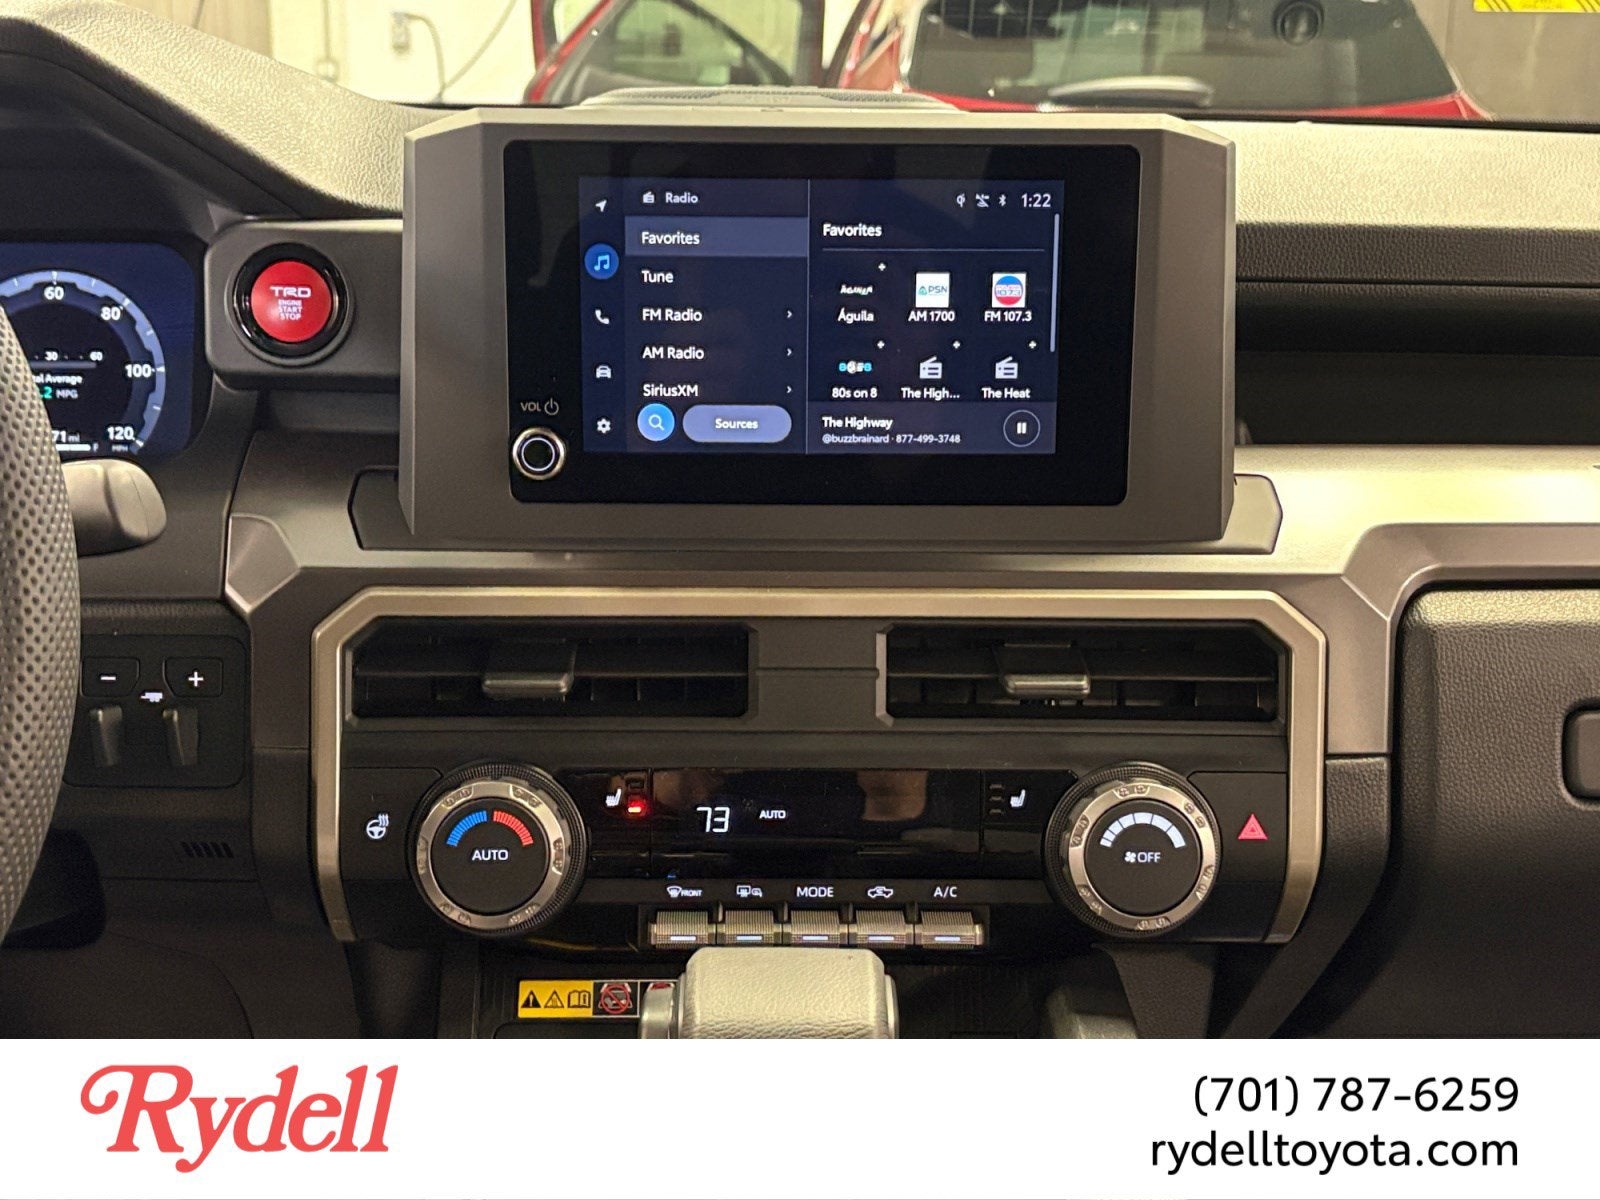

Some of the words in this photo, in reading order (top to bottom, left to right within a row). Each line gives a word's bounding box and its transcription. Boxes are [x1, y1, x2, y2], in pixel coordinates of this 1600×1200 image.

[665, 192, 698, 204] Radio
[1021, 193, 1051, 208] 1:22
[823, 224, 882, 237] Favorites
[641, 231, 700, 245] Favorites
[641, 270, 674, 283] Tune
[44, 286, 64, 300] 60
[269, 286, 312, 298] TRD
[928, 285, 948, 294] PSN
[101, 306, 121, 320] 80
[642, 309, 662, 321] FM
[665, 309, 702, 322] Radio
[838, 307, 874, 324] Águila
[908, 311, 927, 322] AM
[929, 311, 955, 322] 1700
[984, 311, 1001, 322] FM
[1003, 311, 1032, 322] 107.3
[45, 351, 59, 361] 30
[89, 351, 103, 361] 60
[642, 347, 664, 359] AM
[667, 347, 704, 360] Radio
[125, 364, 151, 377] 100
[45, 374, 83, 385] Average
[55, 389, 79, 399] MPG
[643, 384, 699, 397] SiriusXM
[832, 387, 851, 398] 80s
[853, 390, 869, 398] on
[870, 387, 878, 398] 8
[901, 388, 922, 398] The
[923, 387, 960, 401] High...
[982, 388, 1002, 398] The
[1004, 388, 1030, 398] Heat
[520, 401, 541, 411] VOL
[715, 418, 758, 430] Sources
[822, 417, 843, 427] The
[845, 417, 893, 430] Highway
[68, 434, 80, 442] mi
[107, 427, 134, 440] 120
[822, 434, 889, 444] @buzzbrainard
[896, 434, 961, 443] 877-499-3748
[696, 806, 730, 833] 73
[759, 809, 786, 820] AUTO
[471, 849, 509, 861] AUTO
[1137, 852, 1161, 863] OFF
[681, 889, 702, 897] FRONT
[796, 886, 834, 897] MODE
[933, 886, 957, 898] A/C
